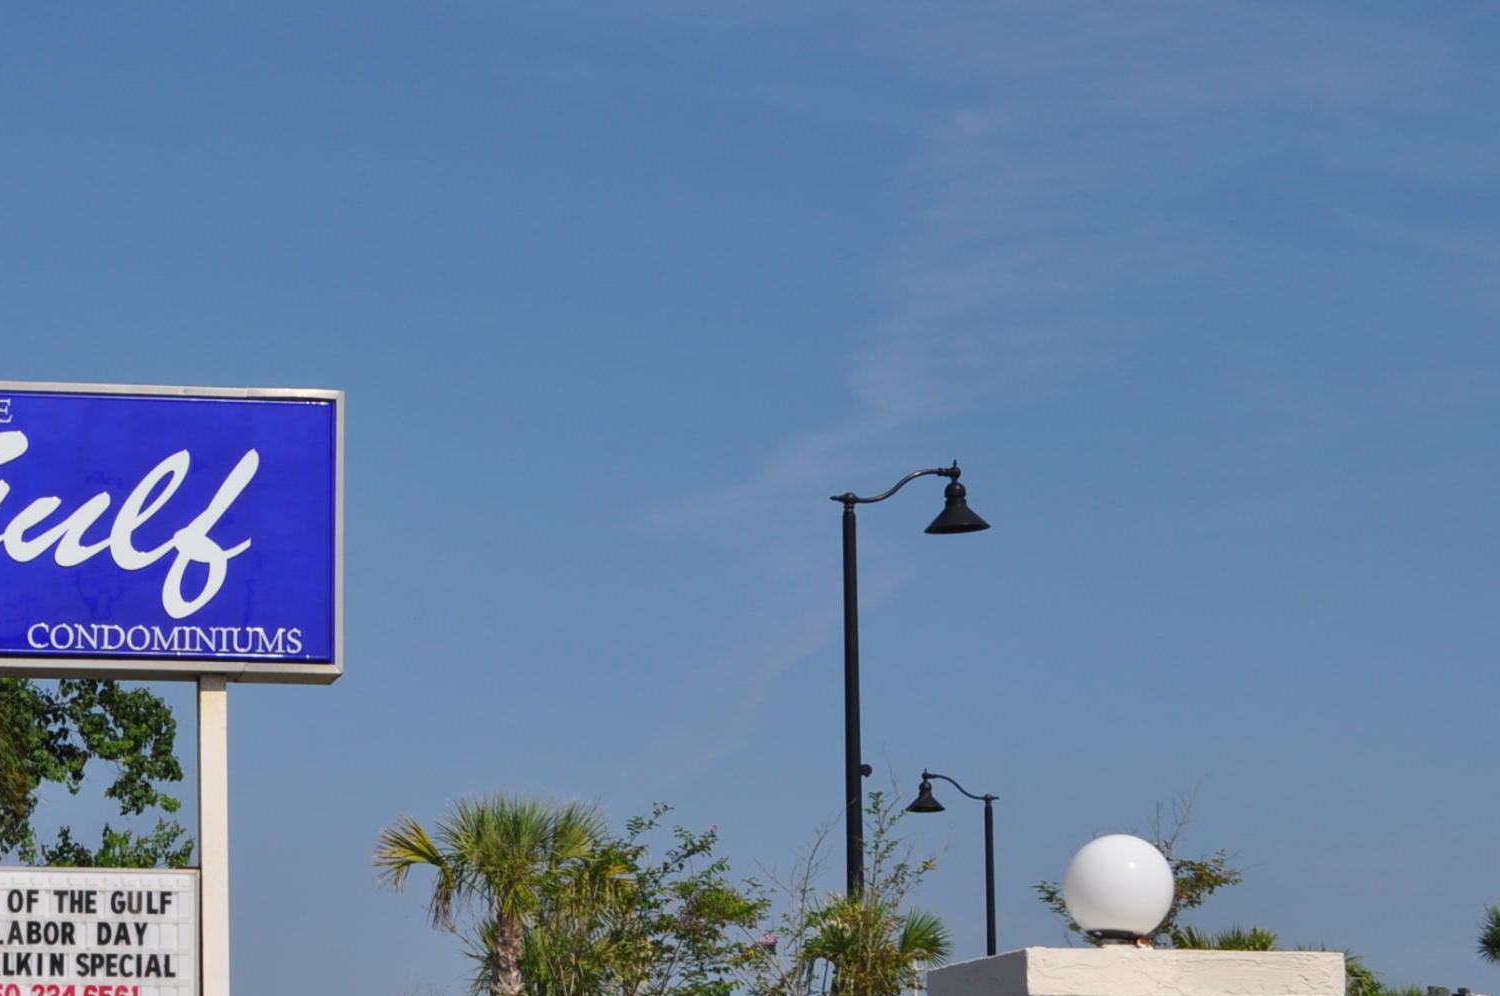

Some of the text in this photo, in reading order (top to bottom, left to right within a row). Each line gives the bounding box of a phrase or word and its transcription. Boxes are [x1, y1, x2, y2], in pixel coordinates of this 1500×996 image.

[26, 622, 303, 654] CONDOMINIUMS
[7, 889, 39, 913] OF
[53, 890, 97, 914] THE
[110, 890, 173, 915] GULF
[96, 922, 148, 946] DAY
[75, 953, 176, 978] SPECIAL
